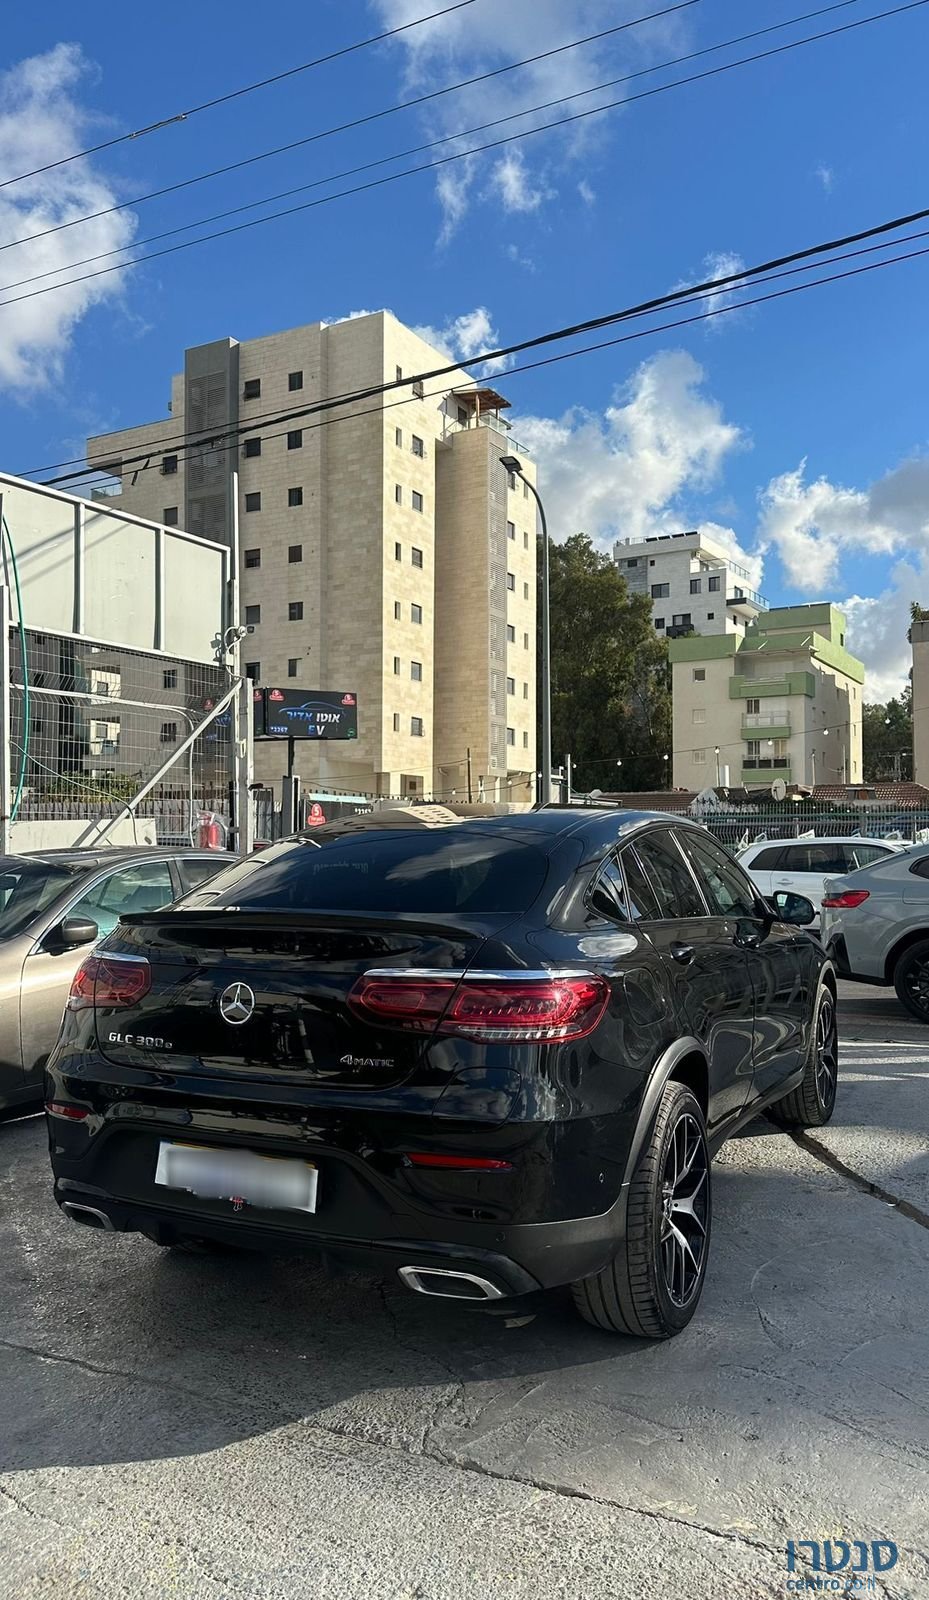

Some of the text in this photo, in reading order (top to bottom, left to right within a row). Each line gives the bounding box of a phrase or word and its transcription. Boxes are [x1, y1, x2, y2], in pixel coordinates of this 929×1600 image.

[287, 711, 341, 723] אוטו אדיר
[308, 725, 325, 736] EV
[313, 806, 320, 817] 5
[108, 1032, 134, 1044] GLC
[340, 1054, 394, 1067] 4MATIC
